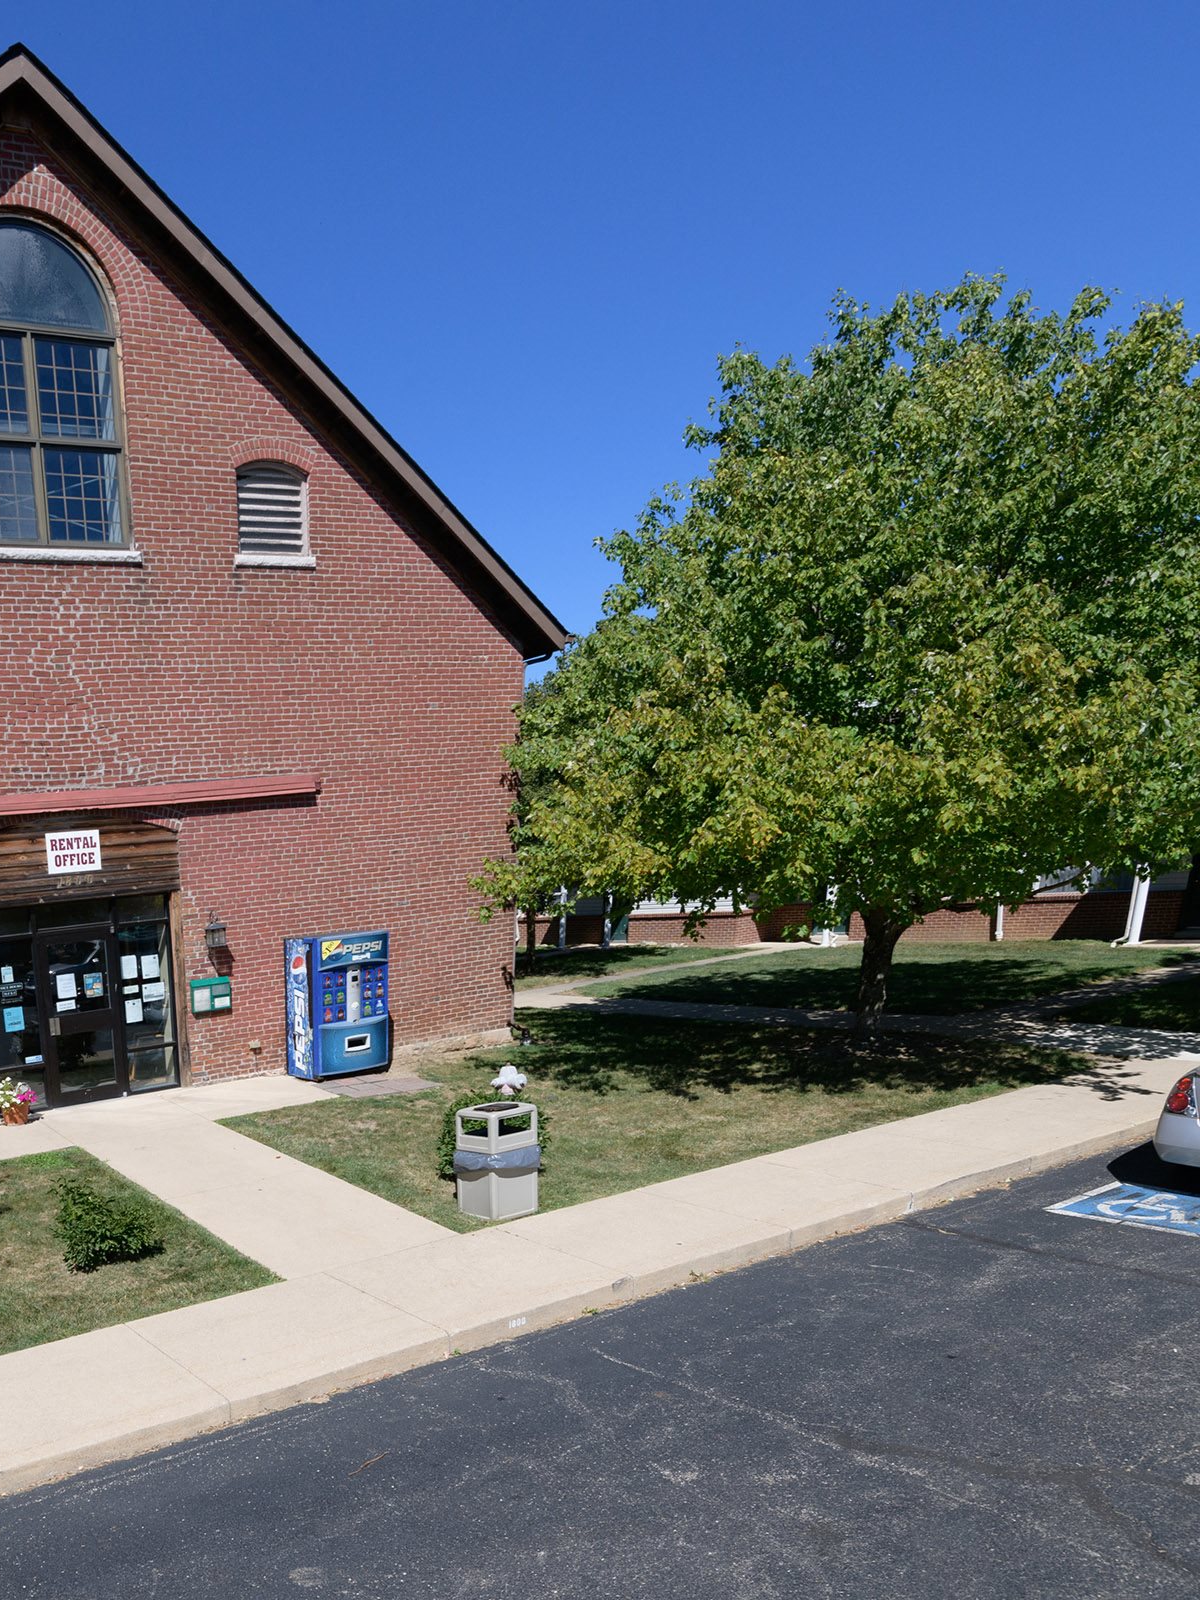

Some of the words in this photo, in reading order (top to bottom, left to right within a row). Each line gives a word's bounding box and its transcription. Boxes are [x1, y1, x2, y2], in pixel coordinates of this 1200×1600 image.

[50, 836, 97, 851] RENTAL
[55, 852, 96, 867] OFFICE
[342, 940, 383, 955] PEPSI
[294, 988, 306, 1071] PEPSI
[508, 1317, 526, 1328] 1800
